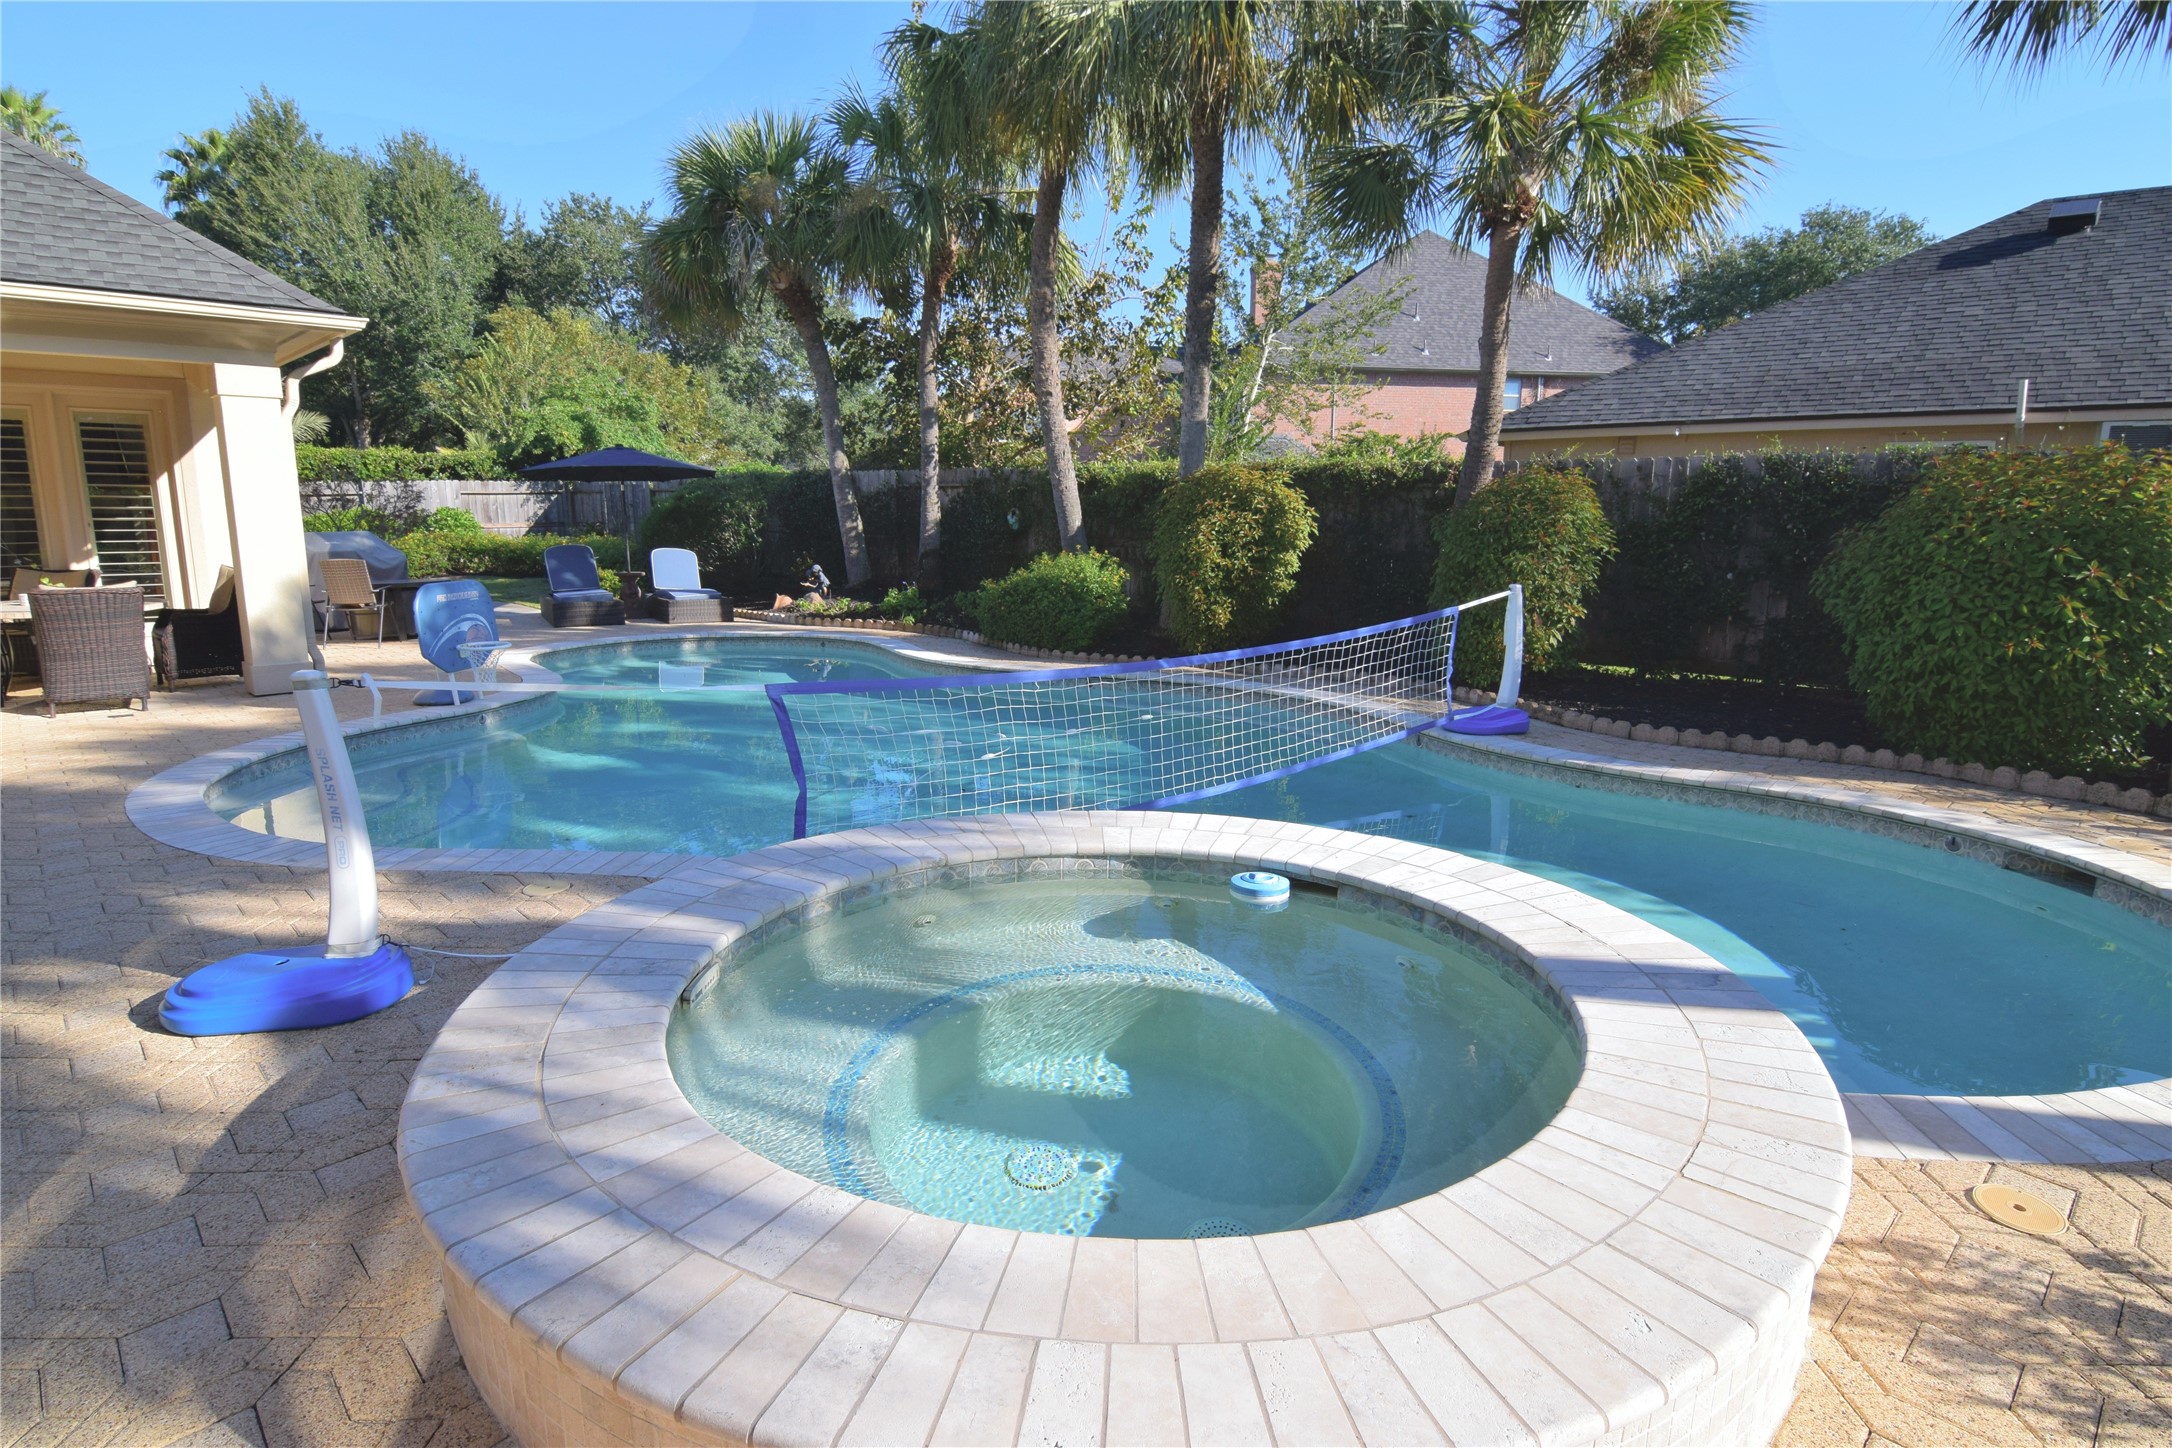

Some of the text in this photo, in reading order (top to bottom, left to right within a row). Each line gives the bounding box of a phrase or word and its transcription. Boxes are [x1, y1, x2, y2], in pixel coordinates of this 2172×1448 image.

[315, 748, 347, 865] SPLASH NET PRO
